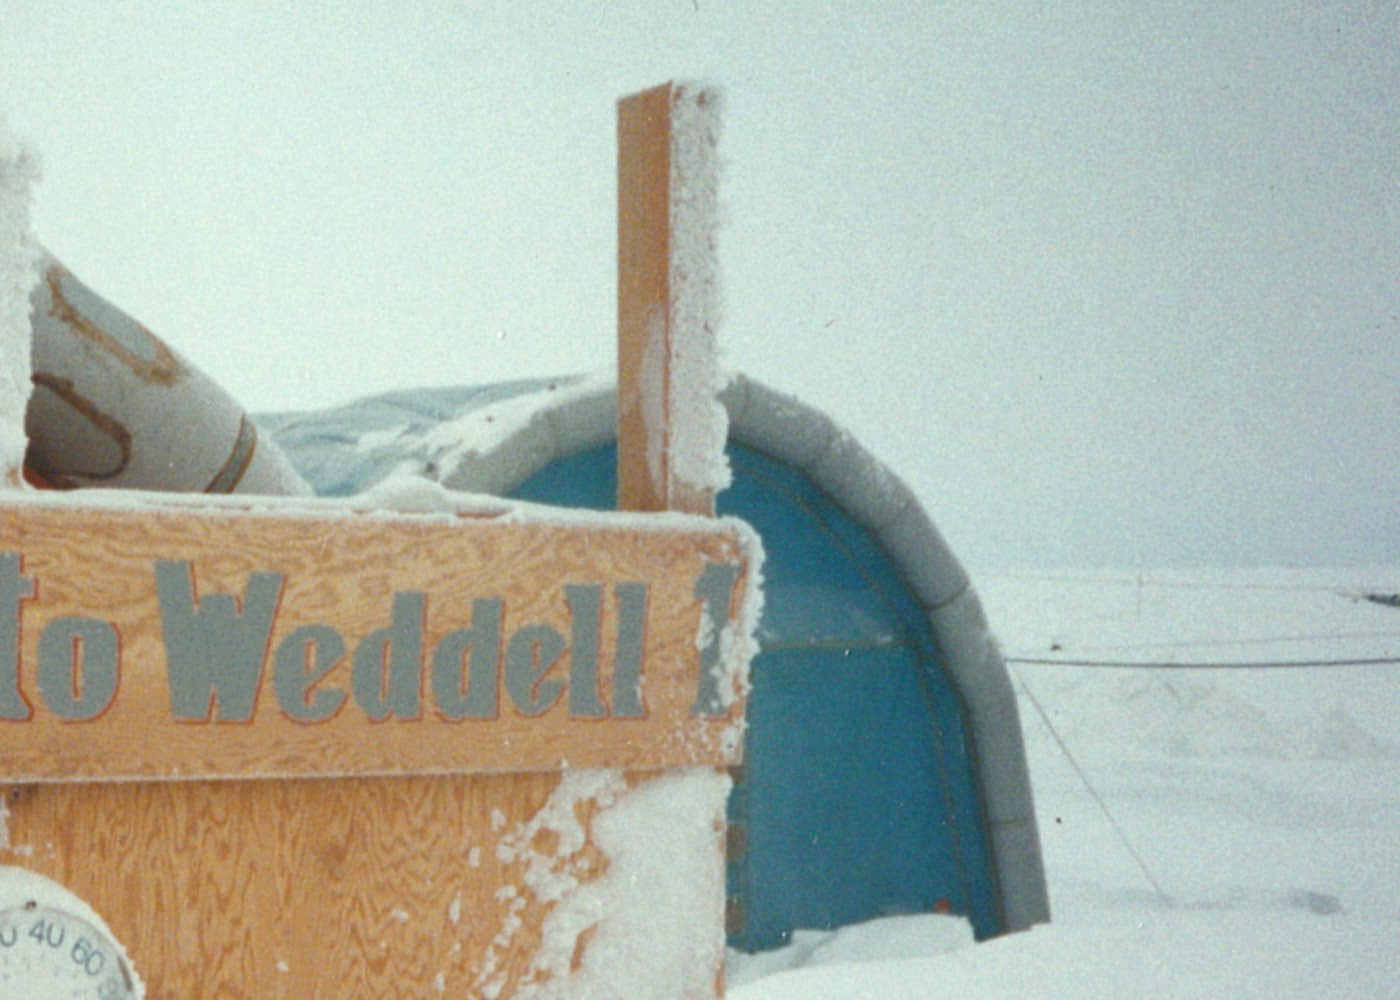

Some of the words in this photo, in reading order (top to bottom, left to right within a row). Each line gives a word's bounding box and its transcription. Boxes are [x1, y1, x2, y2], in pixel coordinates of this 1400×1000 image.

[154, 560, 648, 725] Weddell
[29, 920, 65, 948] 40
[70, 937, 104, 976] 60
